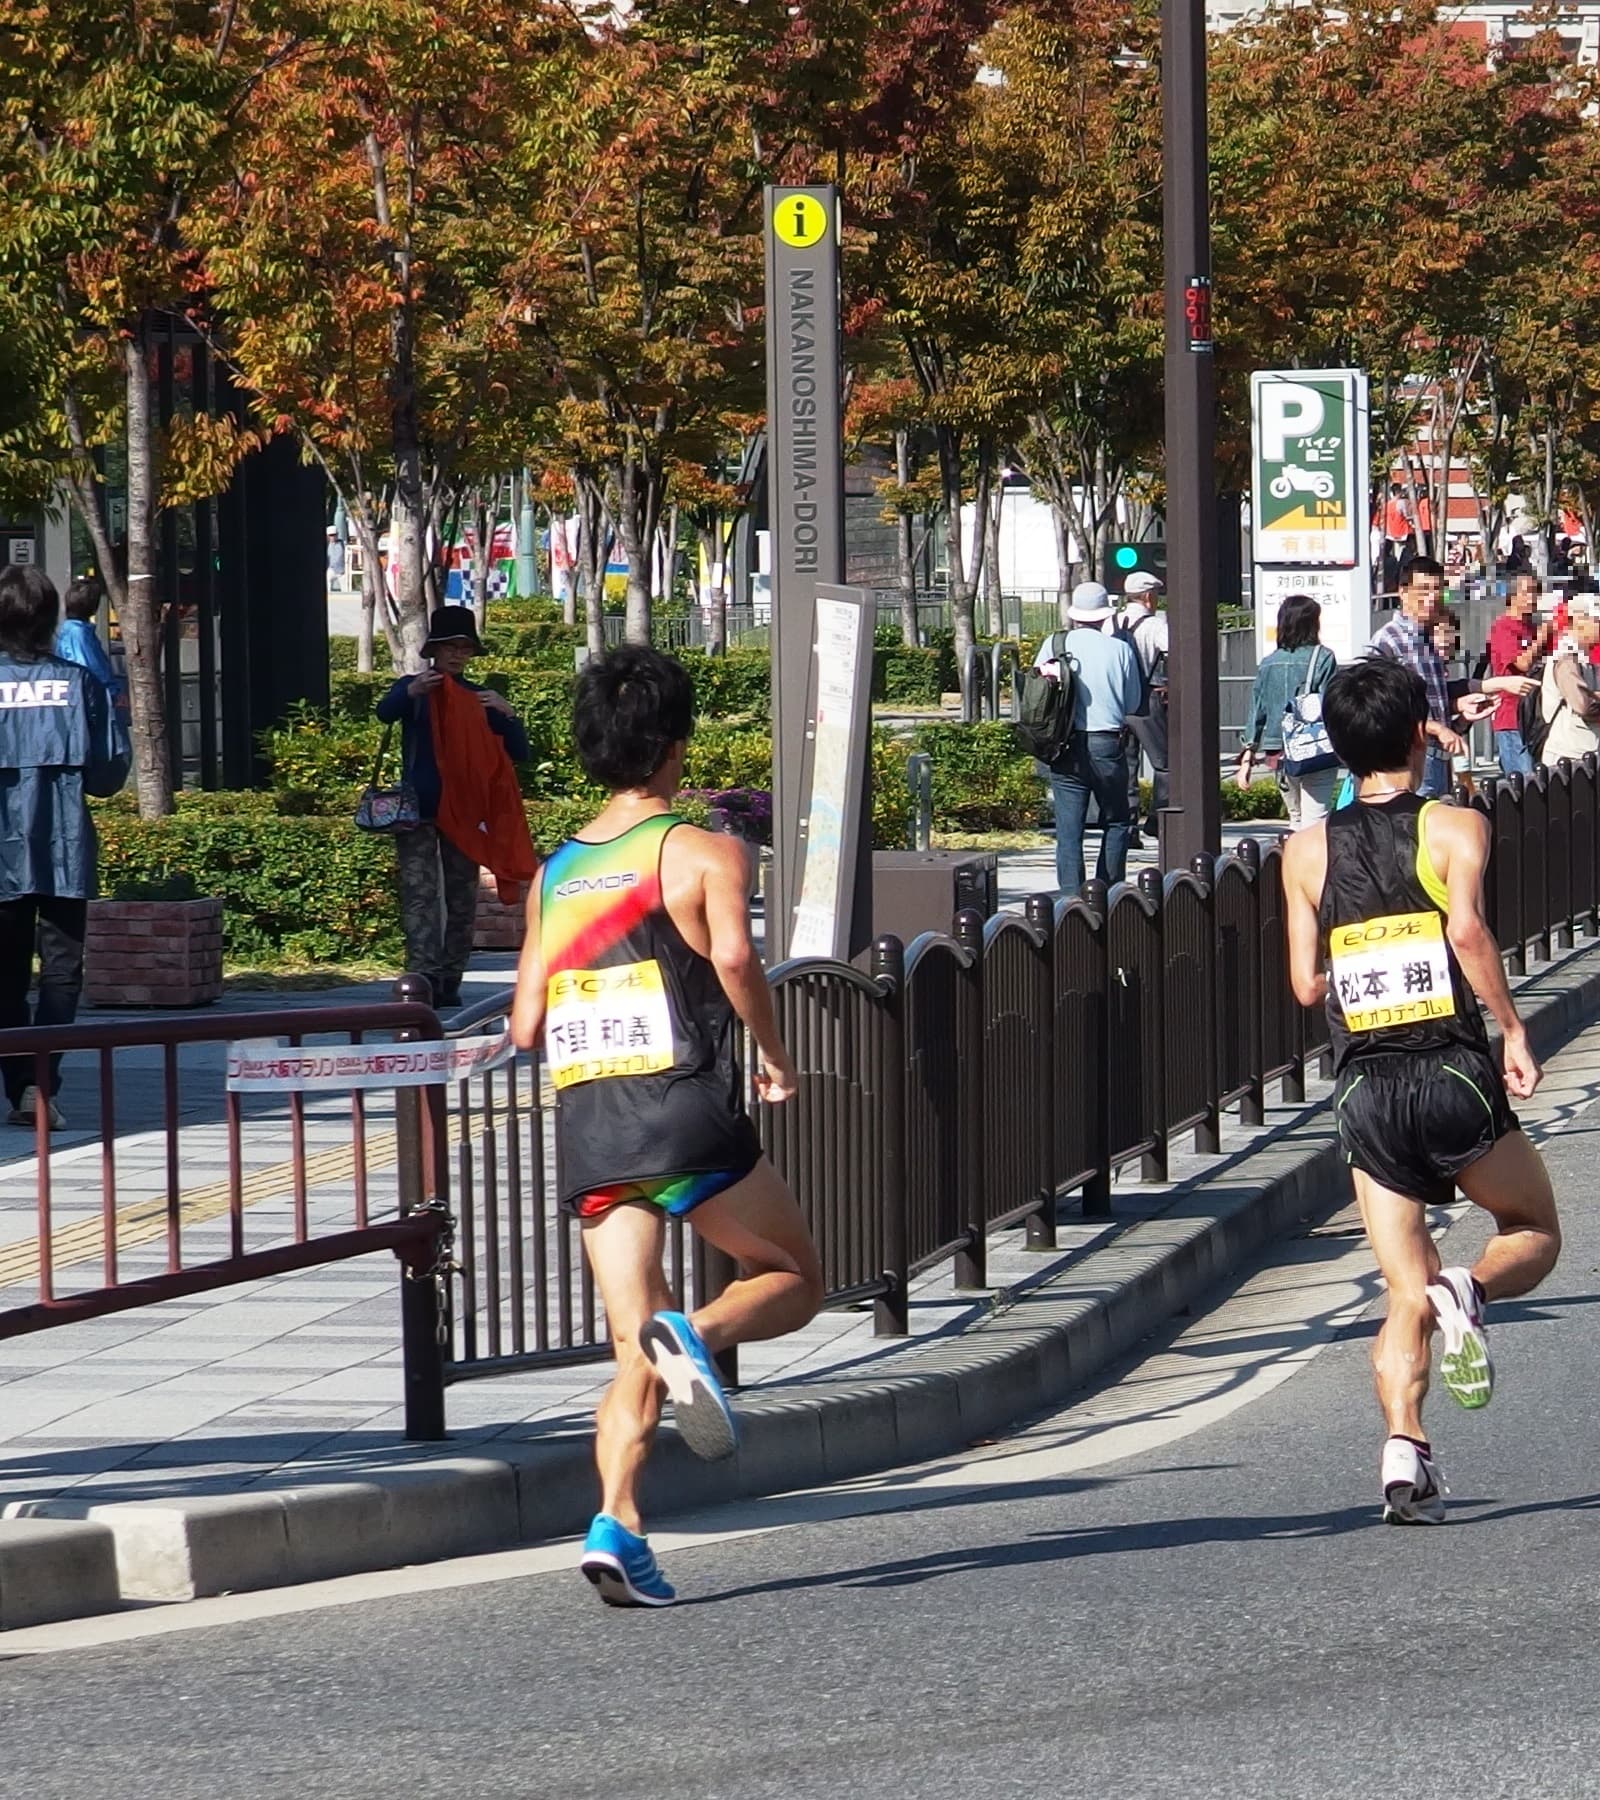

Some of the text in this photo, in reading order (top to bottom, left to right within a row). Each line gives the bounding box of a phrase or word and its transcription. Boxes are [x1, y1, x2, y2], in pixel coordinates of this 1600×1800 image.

[789, 268, 818, 574] NAKANOSHIMA-DORI
[1261, 381, 1324, 462] P
[1297, 437, 1341, 449] バイク
[1315, 500, 1342, 514] IN
[1281, 535, 1326, 554] 有料
[1276, 575, 1334, 589] 対向車に
[0, 680, 69, 702] TAFF
[556, 873, 636, 896] KOMORI
[1340, 961, 1433, 1006] 松本 翔
[600, 1016, 651, 1047] 和義
